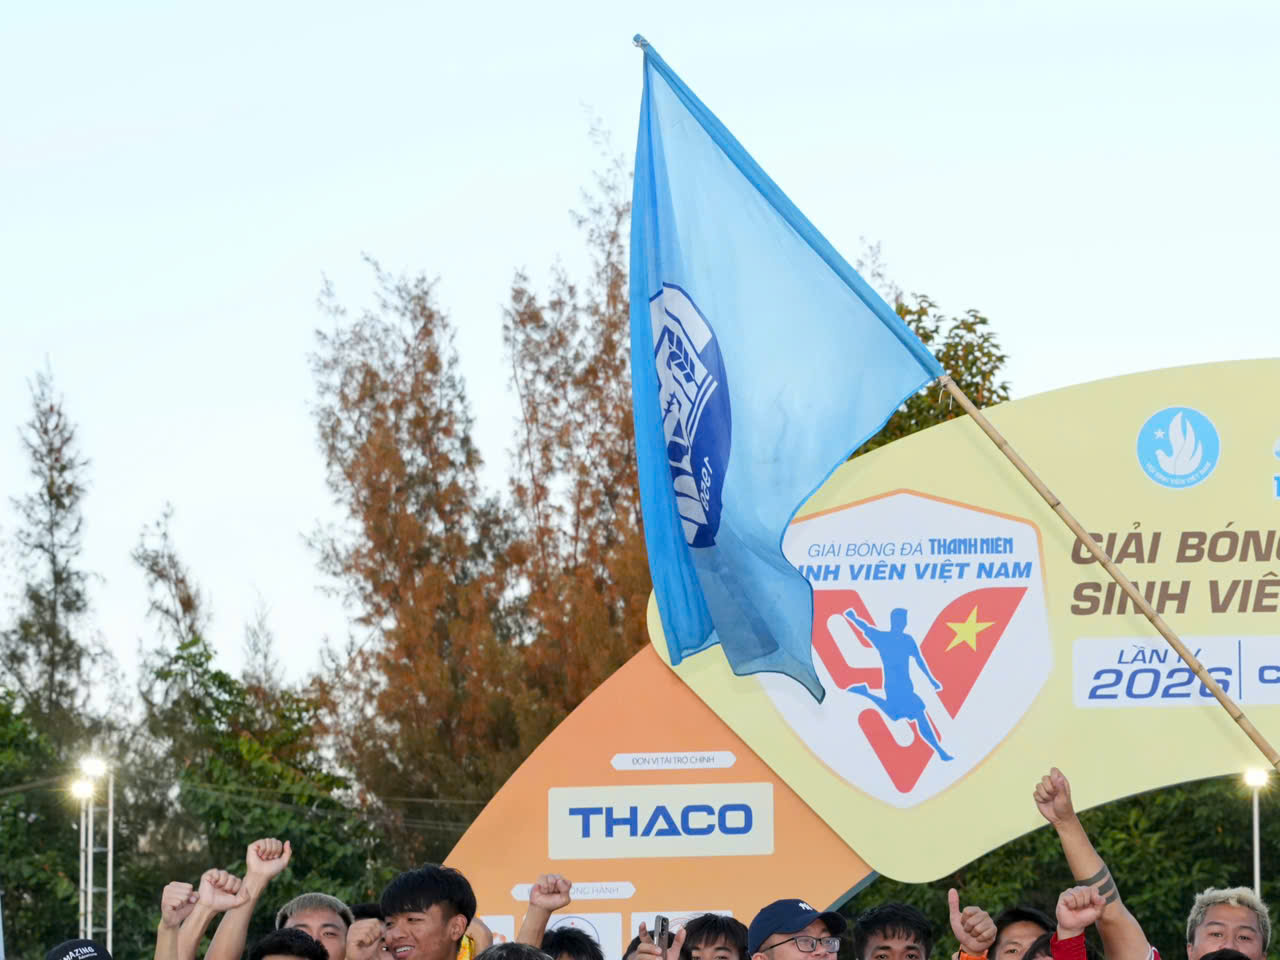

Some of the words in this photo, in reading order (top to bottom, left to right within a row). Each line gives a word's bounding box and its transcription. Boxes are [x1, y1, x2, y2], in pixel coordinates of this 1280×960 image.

[846, 540, 895, 556] BÓNG
[900, 540, 923, 555] ĐÁ
[1071, 521, 1161, 565] GIẢI
[799, 564, 840, 581] INH
[850, 560, 906, 580] VIÊN
[915, 560, 969, 583] VIỆT
[976, 562, 1032, 579] NAM
[1071, 581, 1191, 615] SINH
[1117, 645, 1168, 664] LẦN
[1088, 667, 1232, 699] 2026
[569, 803, 753, 838] THACO
